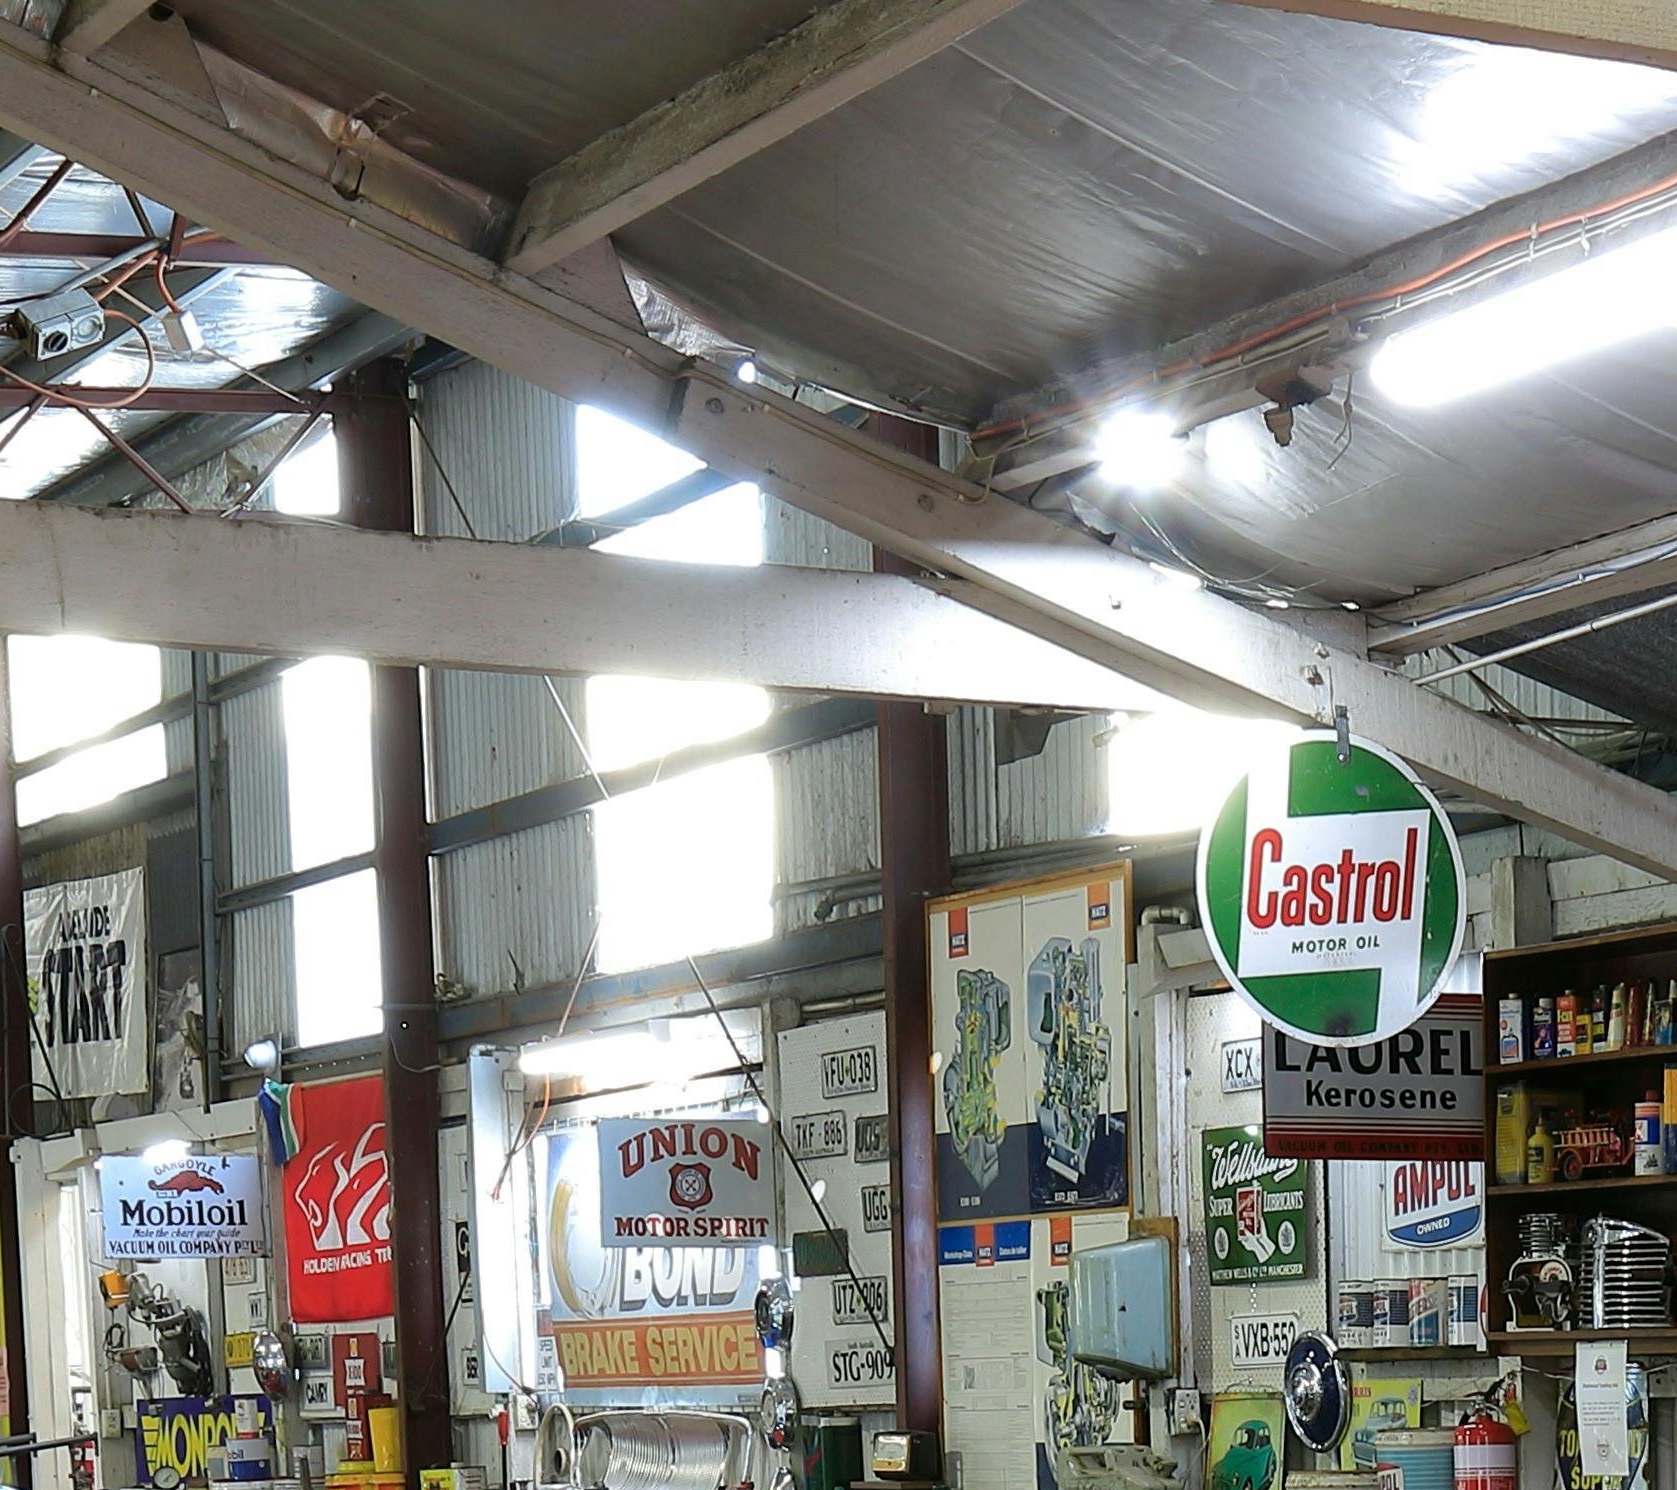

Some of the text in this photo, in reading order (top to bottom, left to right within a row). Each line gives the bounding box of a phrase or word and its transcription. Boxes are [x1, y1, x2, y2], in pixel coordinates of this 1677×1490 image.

[1246, 827, 1417, 930] Castrol
[1290, 936, 1380, 954] MOTOR OIL
[1306, 1080, 1457, 1110] Kerosene
[618, 1123, 761, 1181] UNION
[1393, 1161, 1476, 1217] AMPOL
[120, 1199, 248, 1226] Mobiloil
[1209, 1196, 1233, 1217] SUPER
[615, 1216, 769, 1237] MOTOR SPIRIT
[1416, 1217, 1450, 1235] OWNED
[109, 1240, 232, 1254] VACUUM OIL COMPANY
[304, 1256, 342, 1275] HOLDEN
[560, 1328, 640, 1377] BRAKE
[646, 1325, 759, 1376] SERVICE
